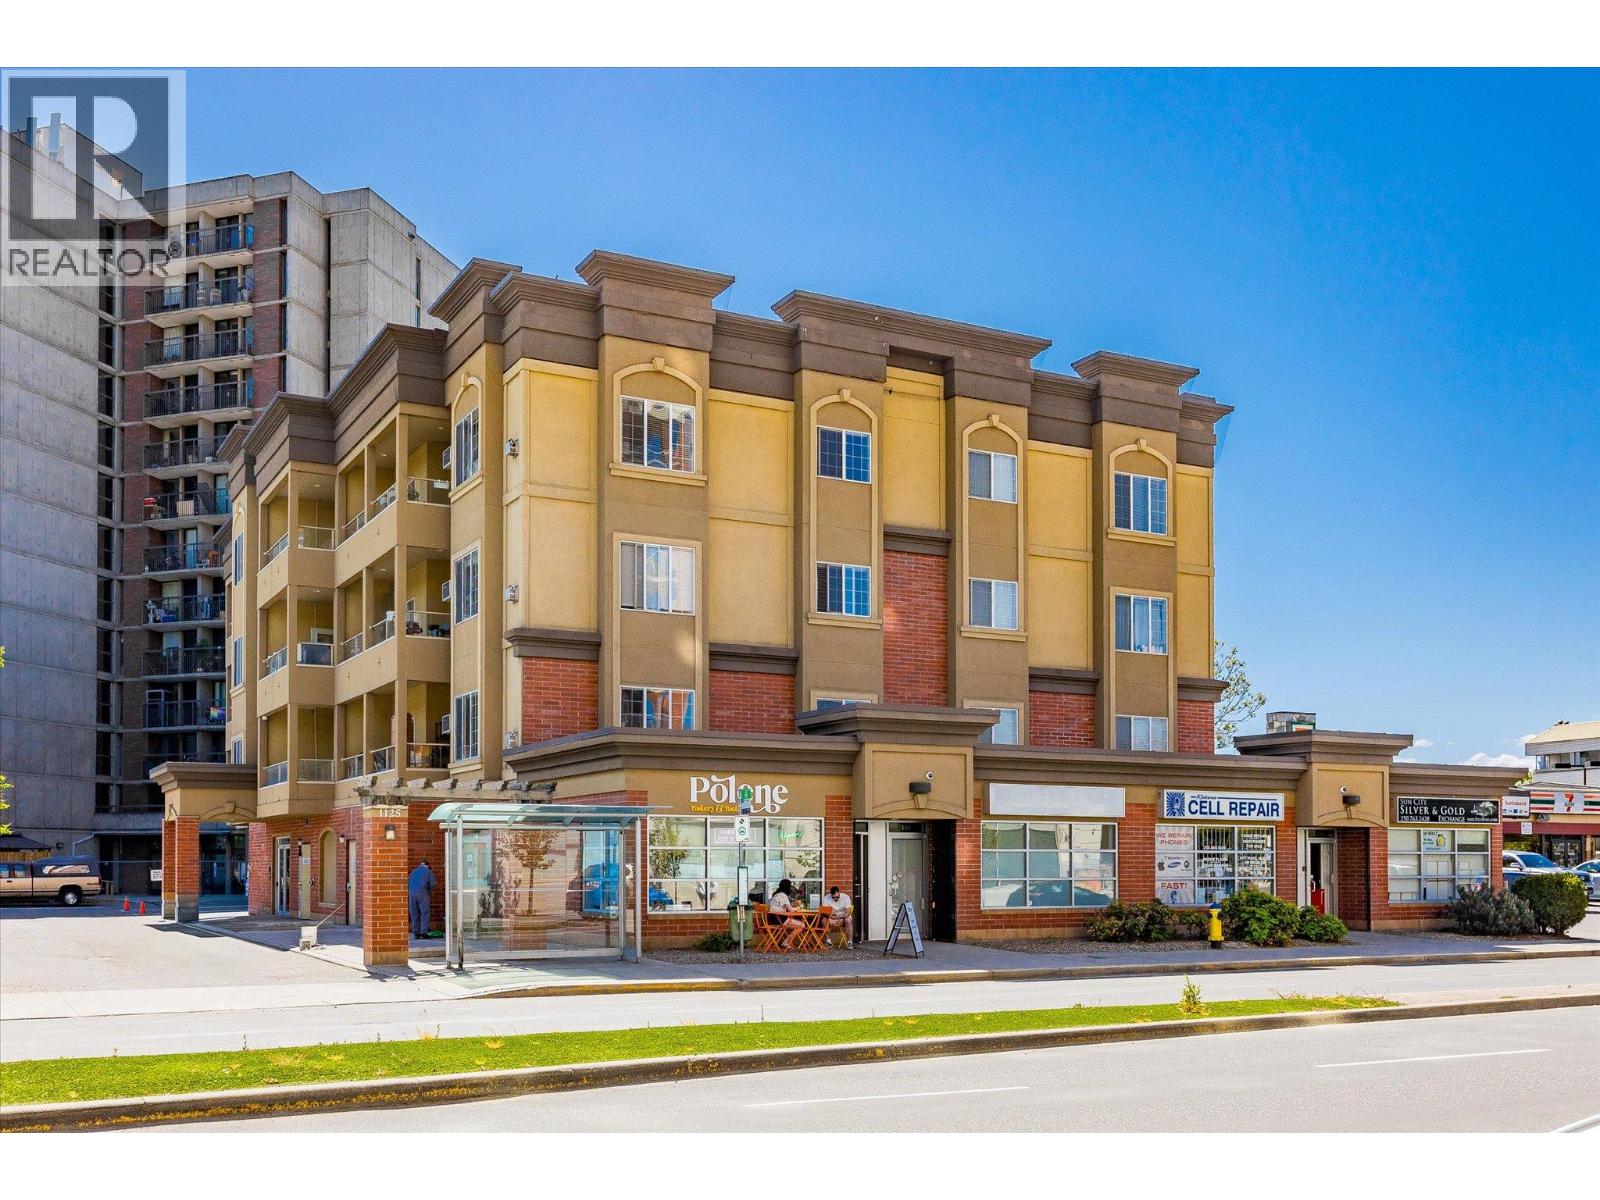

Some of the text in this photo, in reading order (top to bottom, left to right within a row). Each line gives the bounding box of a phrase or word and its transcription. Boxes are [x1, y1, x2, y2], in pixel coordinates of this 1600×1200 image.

[1188, 799, 1280, 817] CELL REPAIR
[1400, 805, 1466, 815] SILVER & GOLD
[379, 809, 401, 818] 1125
[1438, 815, 1466, 823] EXCHANGE
[1161, 882, 1188, 890] FAST!
